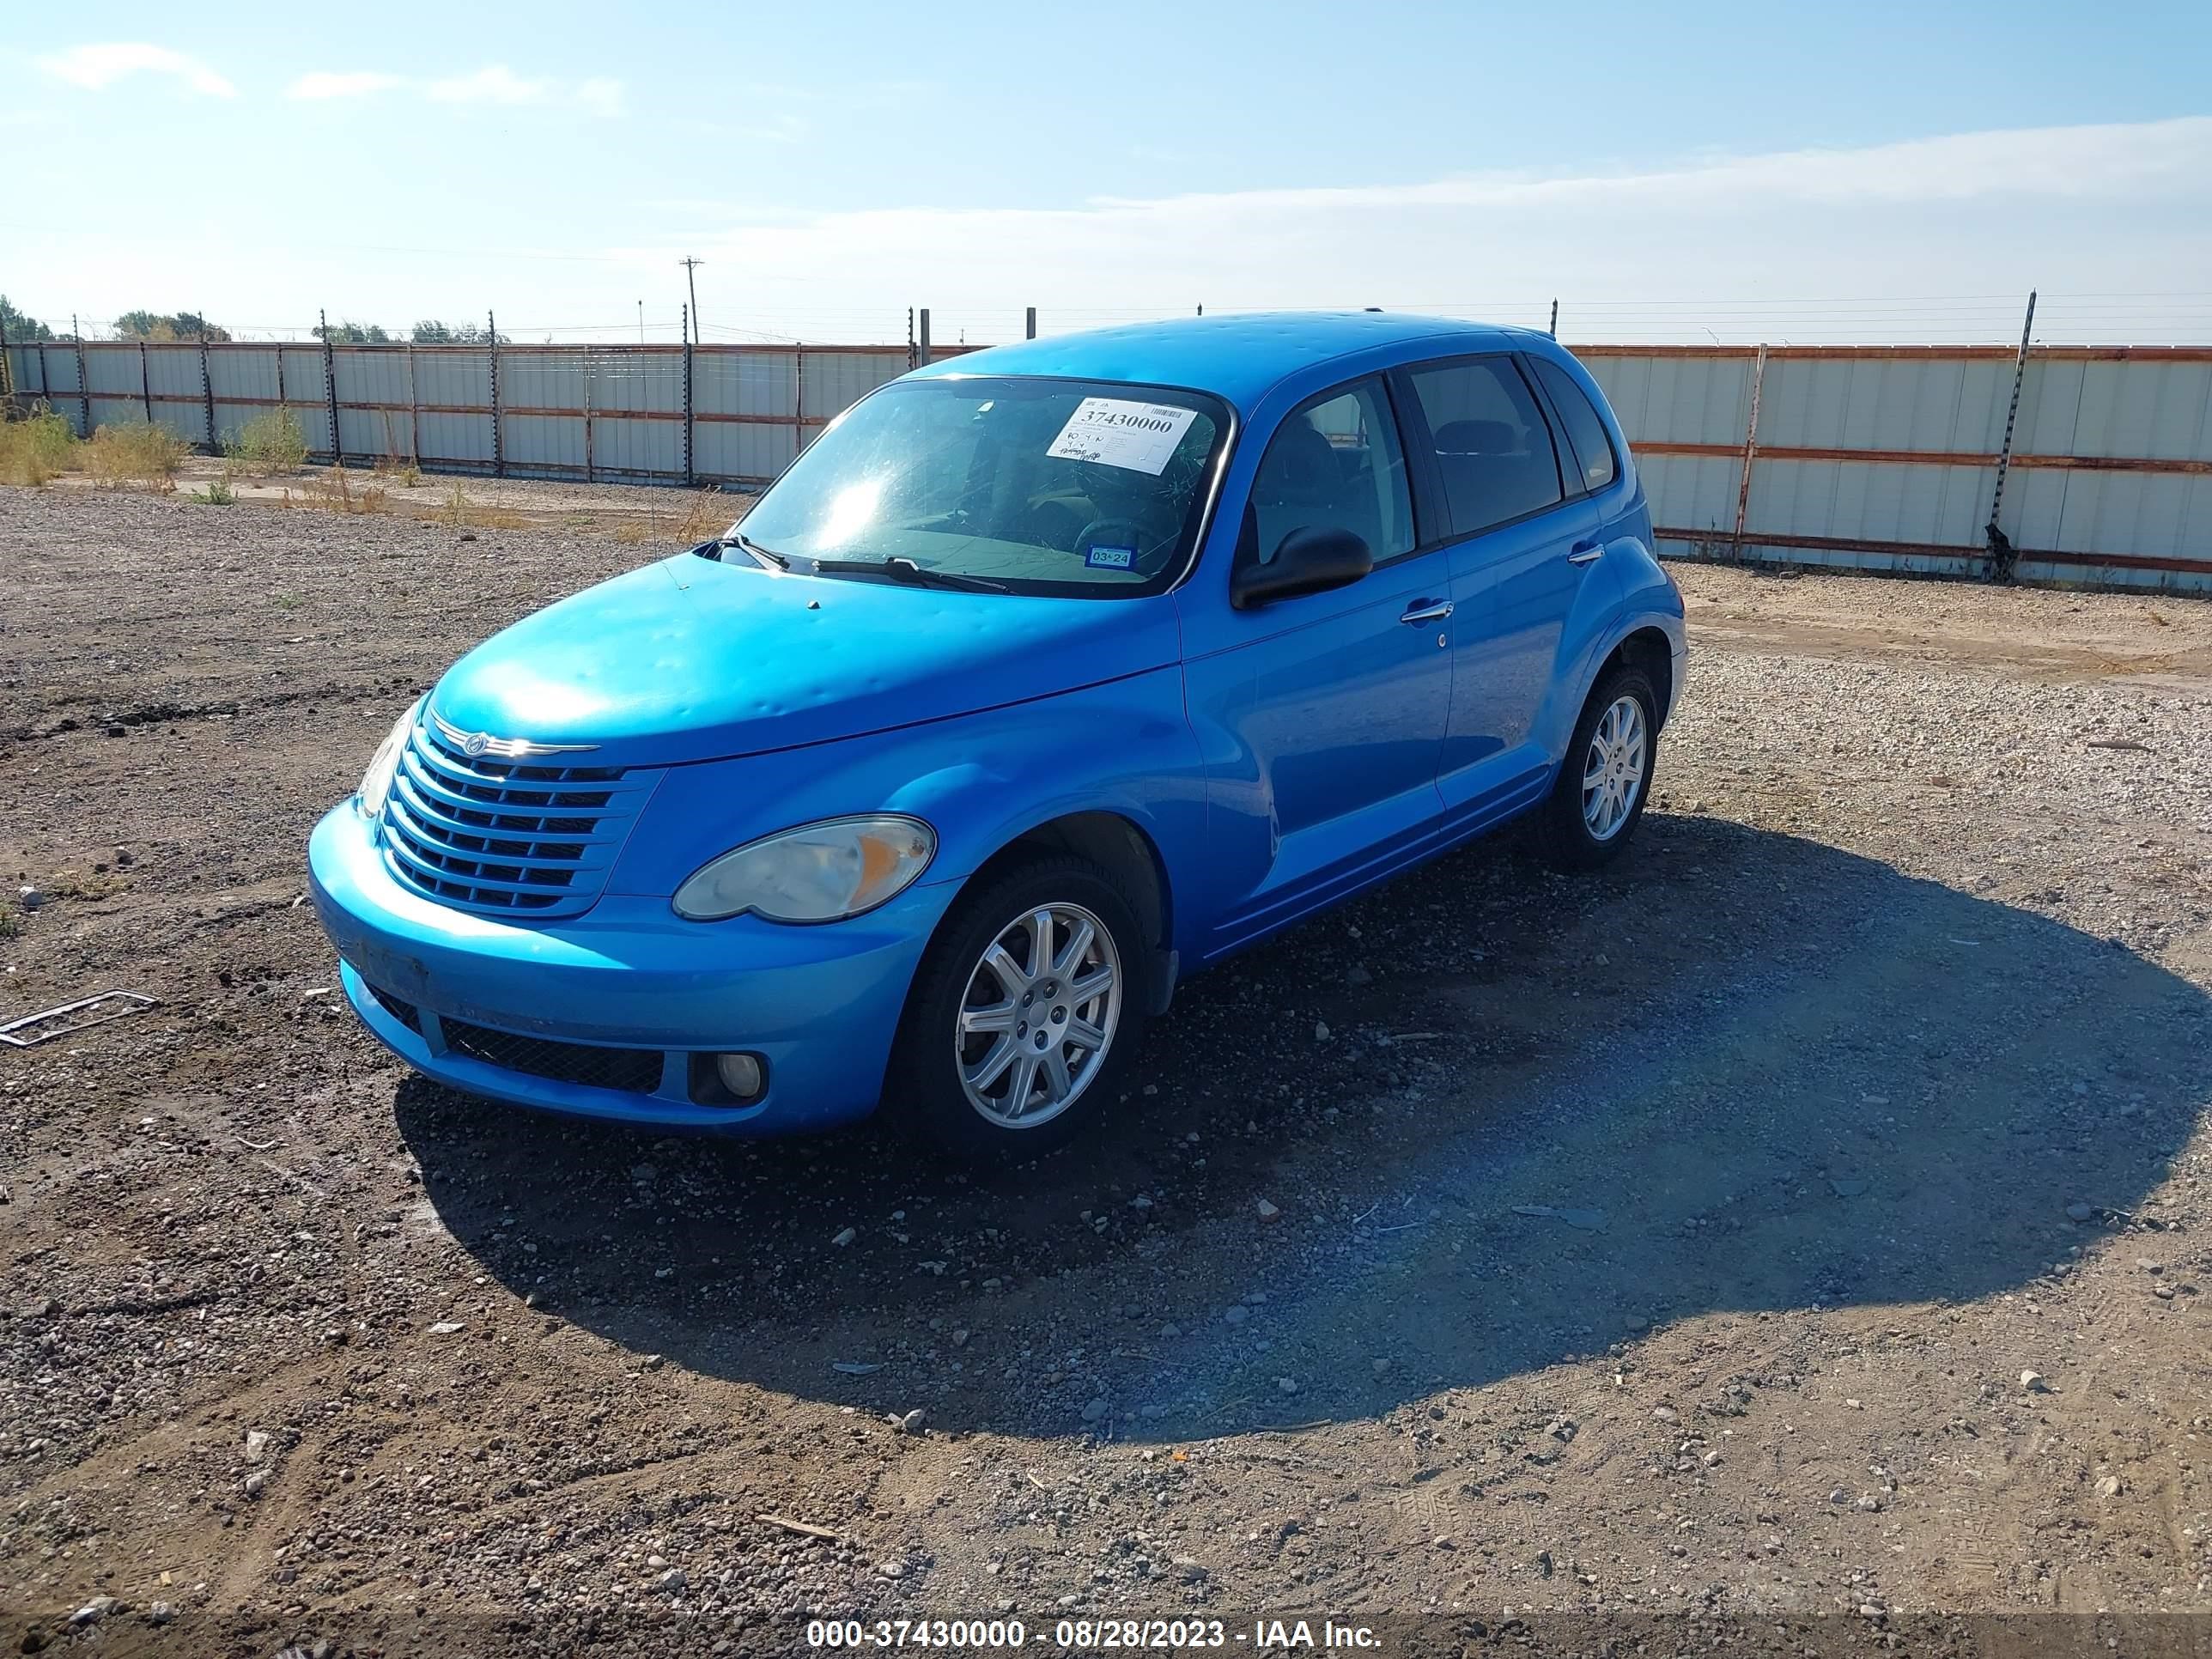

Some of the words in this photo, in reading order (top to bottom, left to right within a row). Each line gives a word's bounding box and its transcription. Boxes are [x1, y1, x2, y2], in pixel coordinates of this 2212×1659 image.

[1081, 410, 1173, 433] 37430000
[1093, 552, 1107, 561] 03
[1113, 554, 1127, 562] 24
